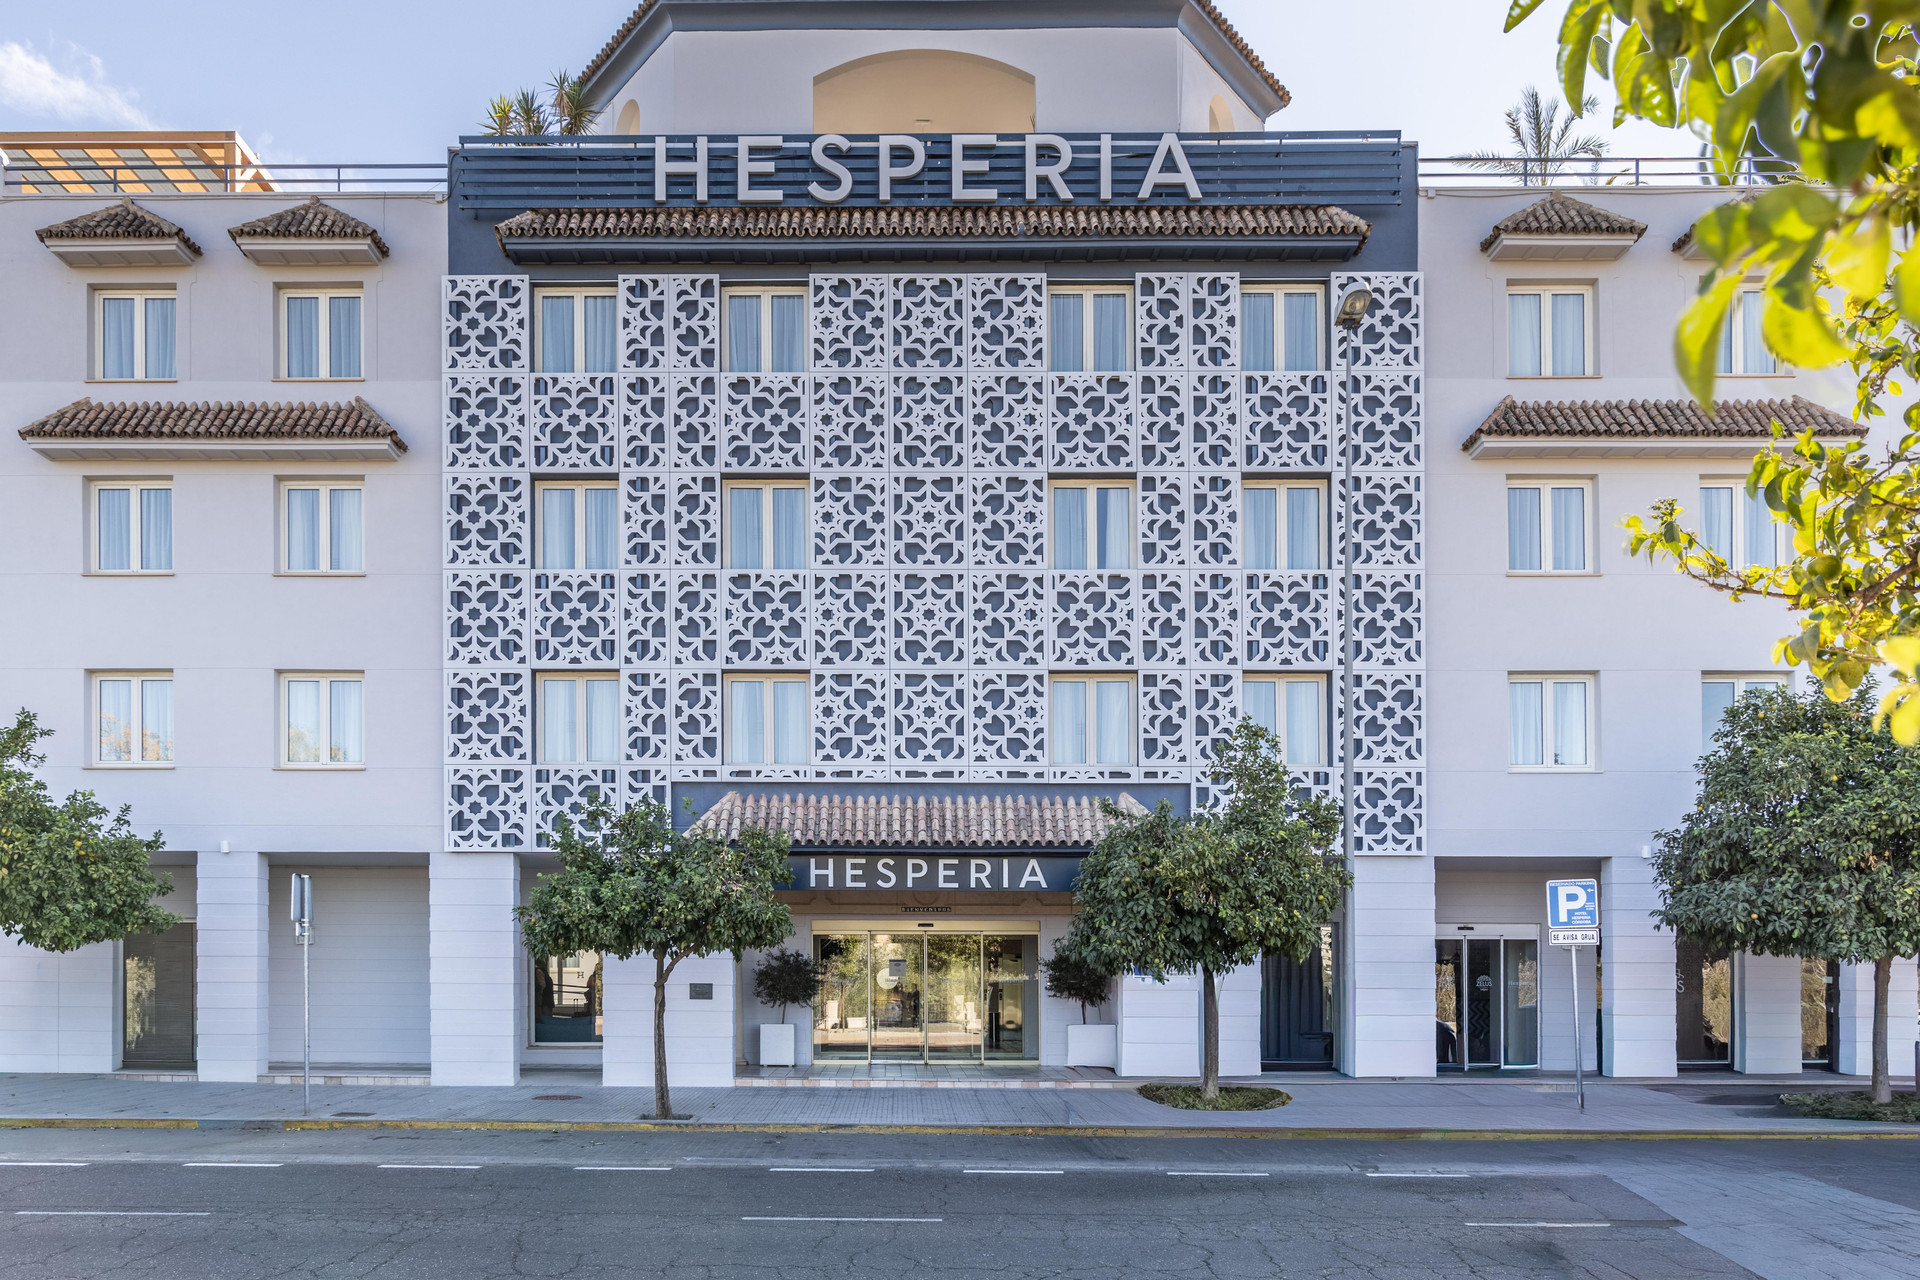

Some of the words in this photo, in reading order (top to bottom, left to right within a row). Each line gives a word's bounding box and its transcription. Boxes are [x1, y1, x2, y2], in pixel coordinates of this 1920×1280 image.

[655, 132, 1203, 204] HESPERIA
[809, 858, 1048, 889] HESPERIA
[1558, 886, 1587, 922] P
